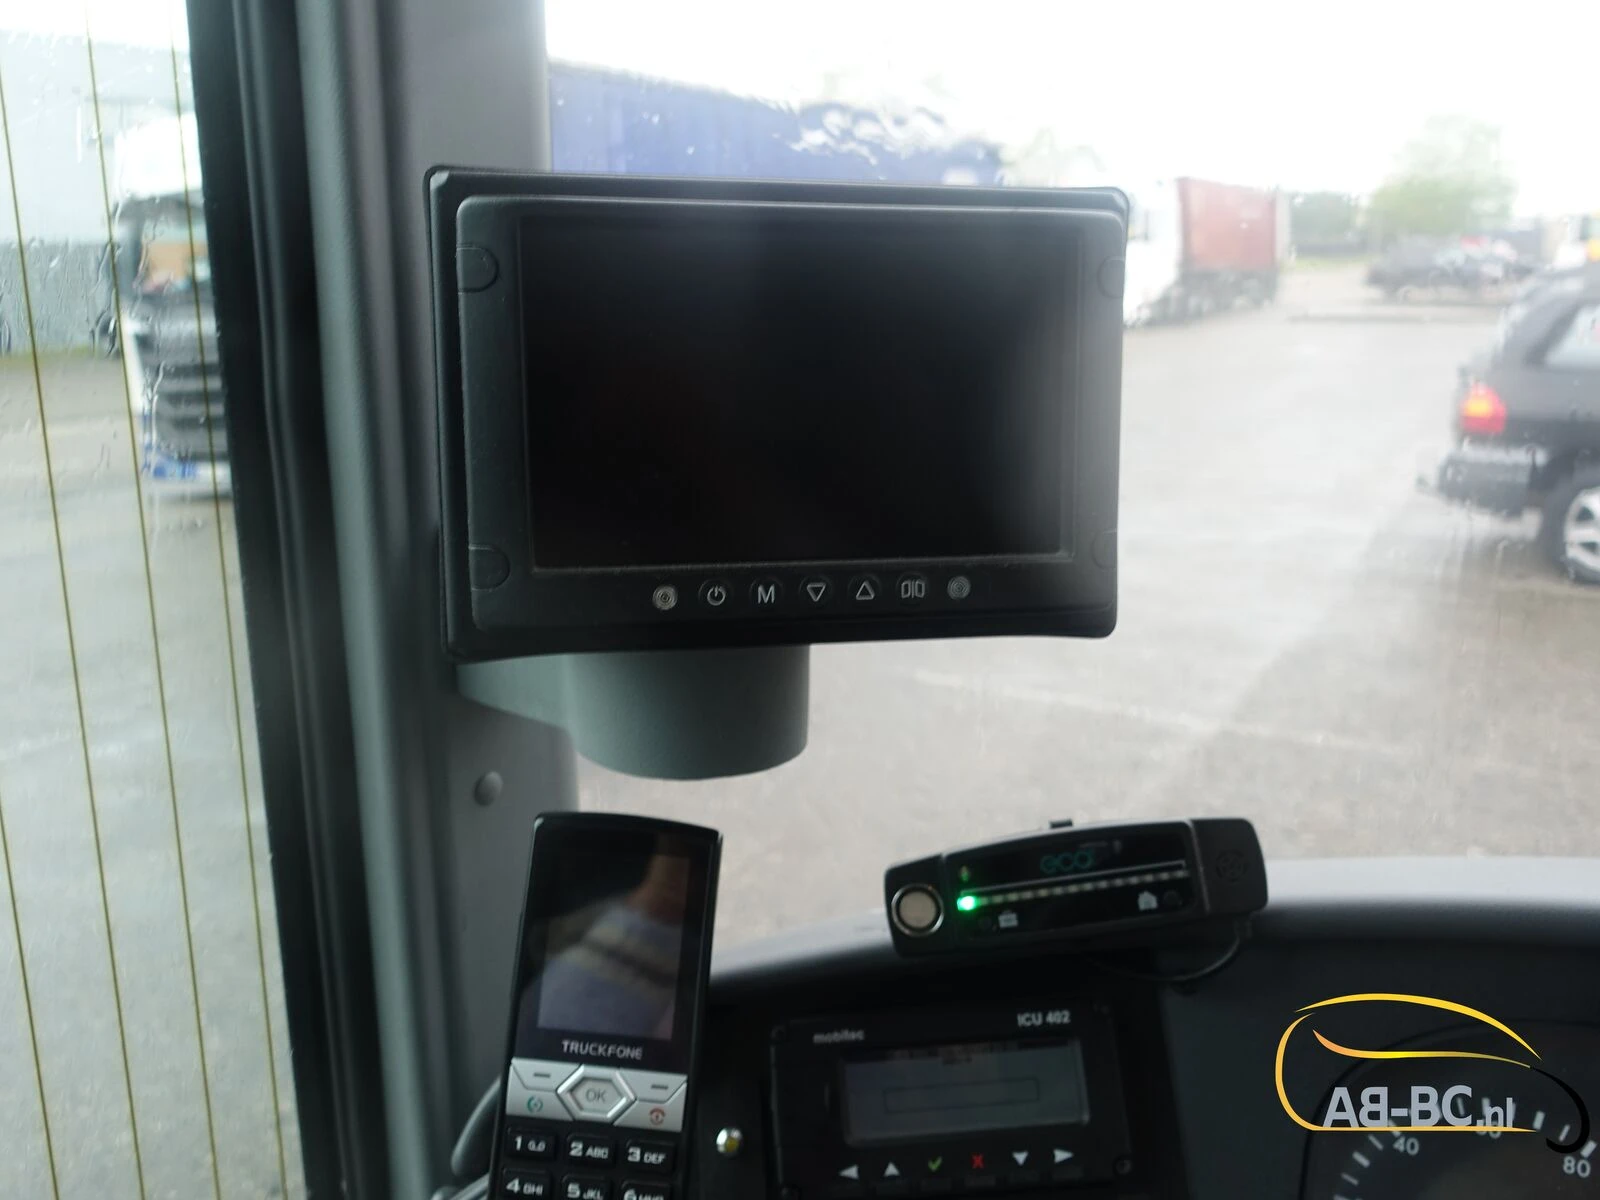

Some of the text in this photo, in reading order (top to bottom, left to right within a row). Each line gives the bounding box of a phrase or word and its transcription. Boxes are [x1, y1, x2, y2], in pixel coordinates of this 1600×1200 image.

[757, 584, 775, 604] M
[1017, 1010, 1071, 1027] ICU 402
[561, 1039, 643, 1060] TRUCKFONE
[585, 1088, 606, 1102] OK
[514, 1135, 522, 1150] 1
[569, 1141, 584, 1157] 2
[1393, 1136, 1419, 1155] 40
[627, 1147, 641, 1162] 3
[1563, 1156, 1591, 1178] 80
[506, 1178, 521, 1193] 4
[567, 1183, 580, 1198] 5
